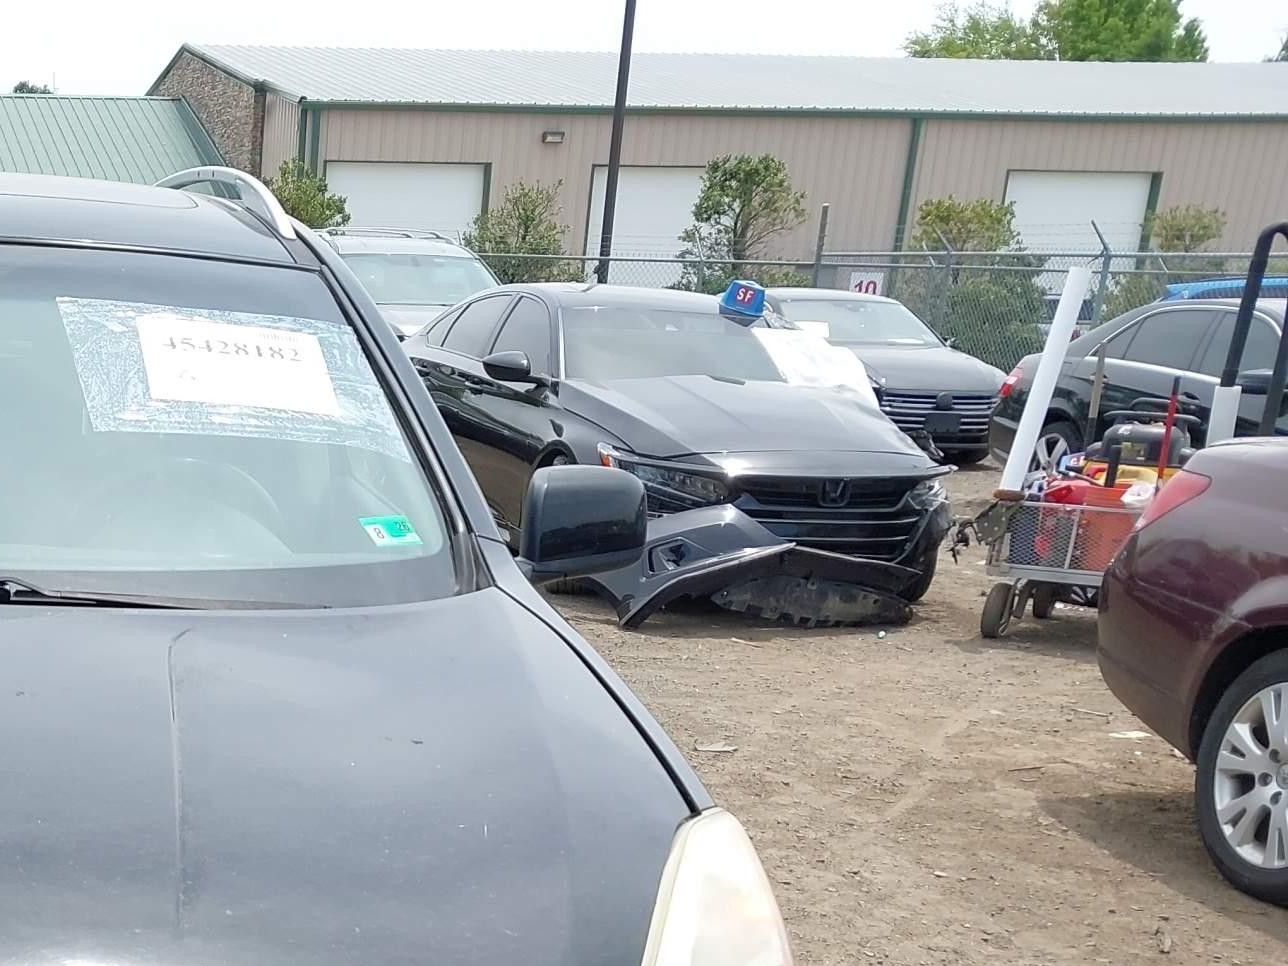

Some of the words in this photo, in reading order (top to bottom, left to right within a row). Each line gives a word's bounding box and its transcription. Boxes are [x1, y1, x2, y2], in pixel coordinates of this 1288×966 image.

[736, 287, 755, 302] SF
[854, 280, 878, 295] 10
[162, 335, 303, 363] 45428182
[373, 527, 385, 539] 8
